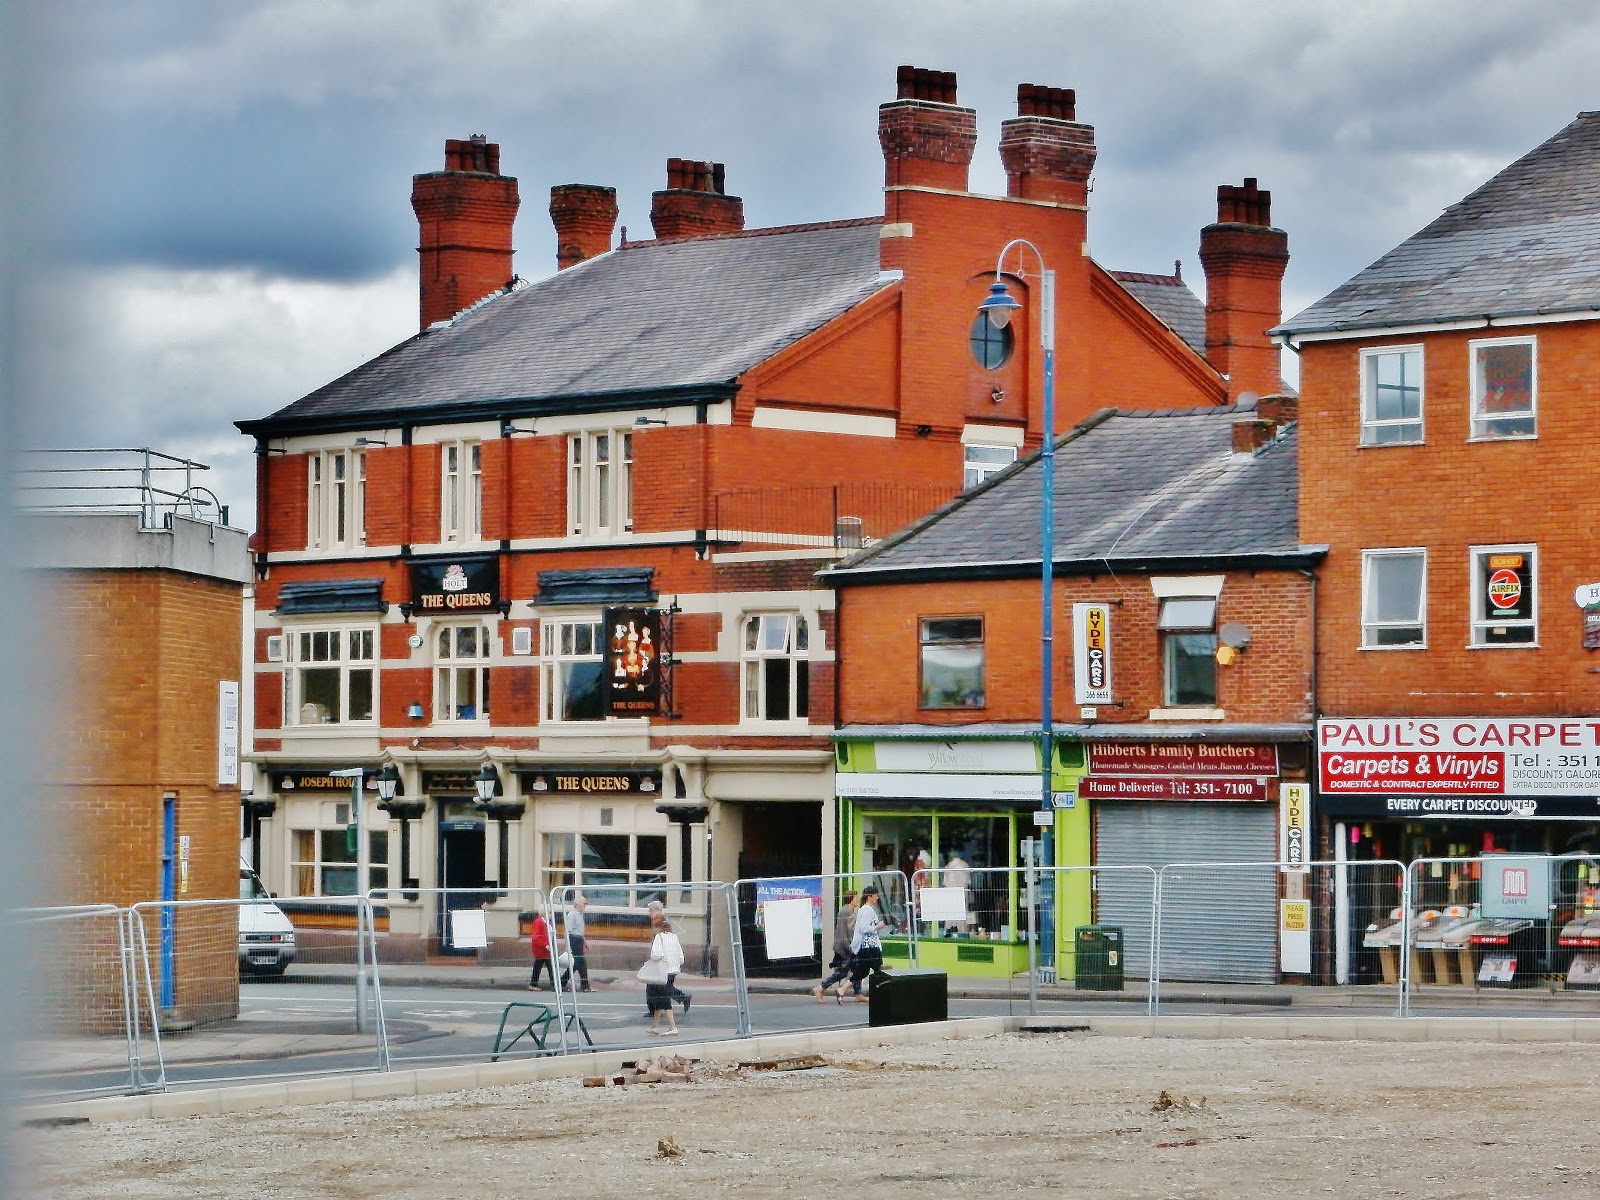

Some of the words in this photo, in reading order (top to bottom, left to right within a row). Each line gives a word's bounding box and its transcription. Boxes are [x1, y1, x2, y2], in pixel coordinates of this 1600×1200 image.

[444, 579, 467, 588] HOLT
[1490, 584, 1520, 593] AIRFIX
[421, 594, 444, 608] THE
[446, 592, 492, 609] QUEENS
[1090, 611, 1101, 647] HYDE
[1089, 649, 1103, 687] CARS
[612, 701, 627, 709] THE
[627, 701, 655, 709] QUEENS
[1321, 721, 1440, 747] PAUL'S
[1092, 743, 1146, 756] Hibberts
[1150, 743, 1194, 760] Family
[1198, 743, 1255, 757] Butchers
[1092, 761, 1132, 769] Homemade
[1327, 754, 1410, 779] Carpets
[1415, 754, 1431, 774] &
[1436, 754, 1499, 779] Vinyls
[1557, 755, 1587, 767] 351
[1512, 769, 1563, 779] DISCOUNTS
[299, 776, 333, 788] JOSEPH
[335, 776, 357, 788] HOL
[556, 776, 580, 790] THE
[581, 776, 630, 792] QUEENS
[1089, 781, 1116, 793] Home
[1119, 781, 1164, 793] Deliveries
[1169, 781, 1190, 795] Tel:
[1223, 783, 1253, 795] 7100
[1330, 780, 1372, 789] DOMESTIC
[1372, 780, 1380, 788] &
[1381, 780, 1426, 789] CONTRACT
[1427, 780, 1469, 789] EXPERTLY
[1470, 781, 1500, 789] FITTED
[1512, 781, 1532, 789] EXTRA
[1533, 781, 1569, 789] DISCOUNTS
[1570, 781, 1584, 789] FOR
[1289, 788, 1301, 826] HYDE
[1387, 799, 1420, 810] EVERY
[1421, 799, 1464, 811] CARPET
[1466, 800, 1538, 812] DISCOUNTED
[757, 886, 769, 895] ALL
[770, 887, 783, 895] THE
[1285, 921, 1305, 929] BUZZER
